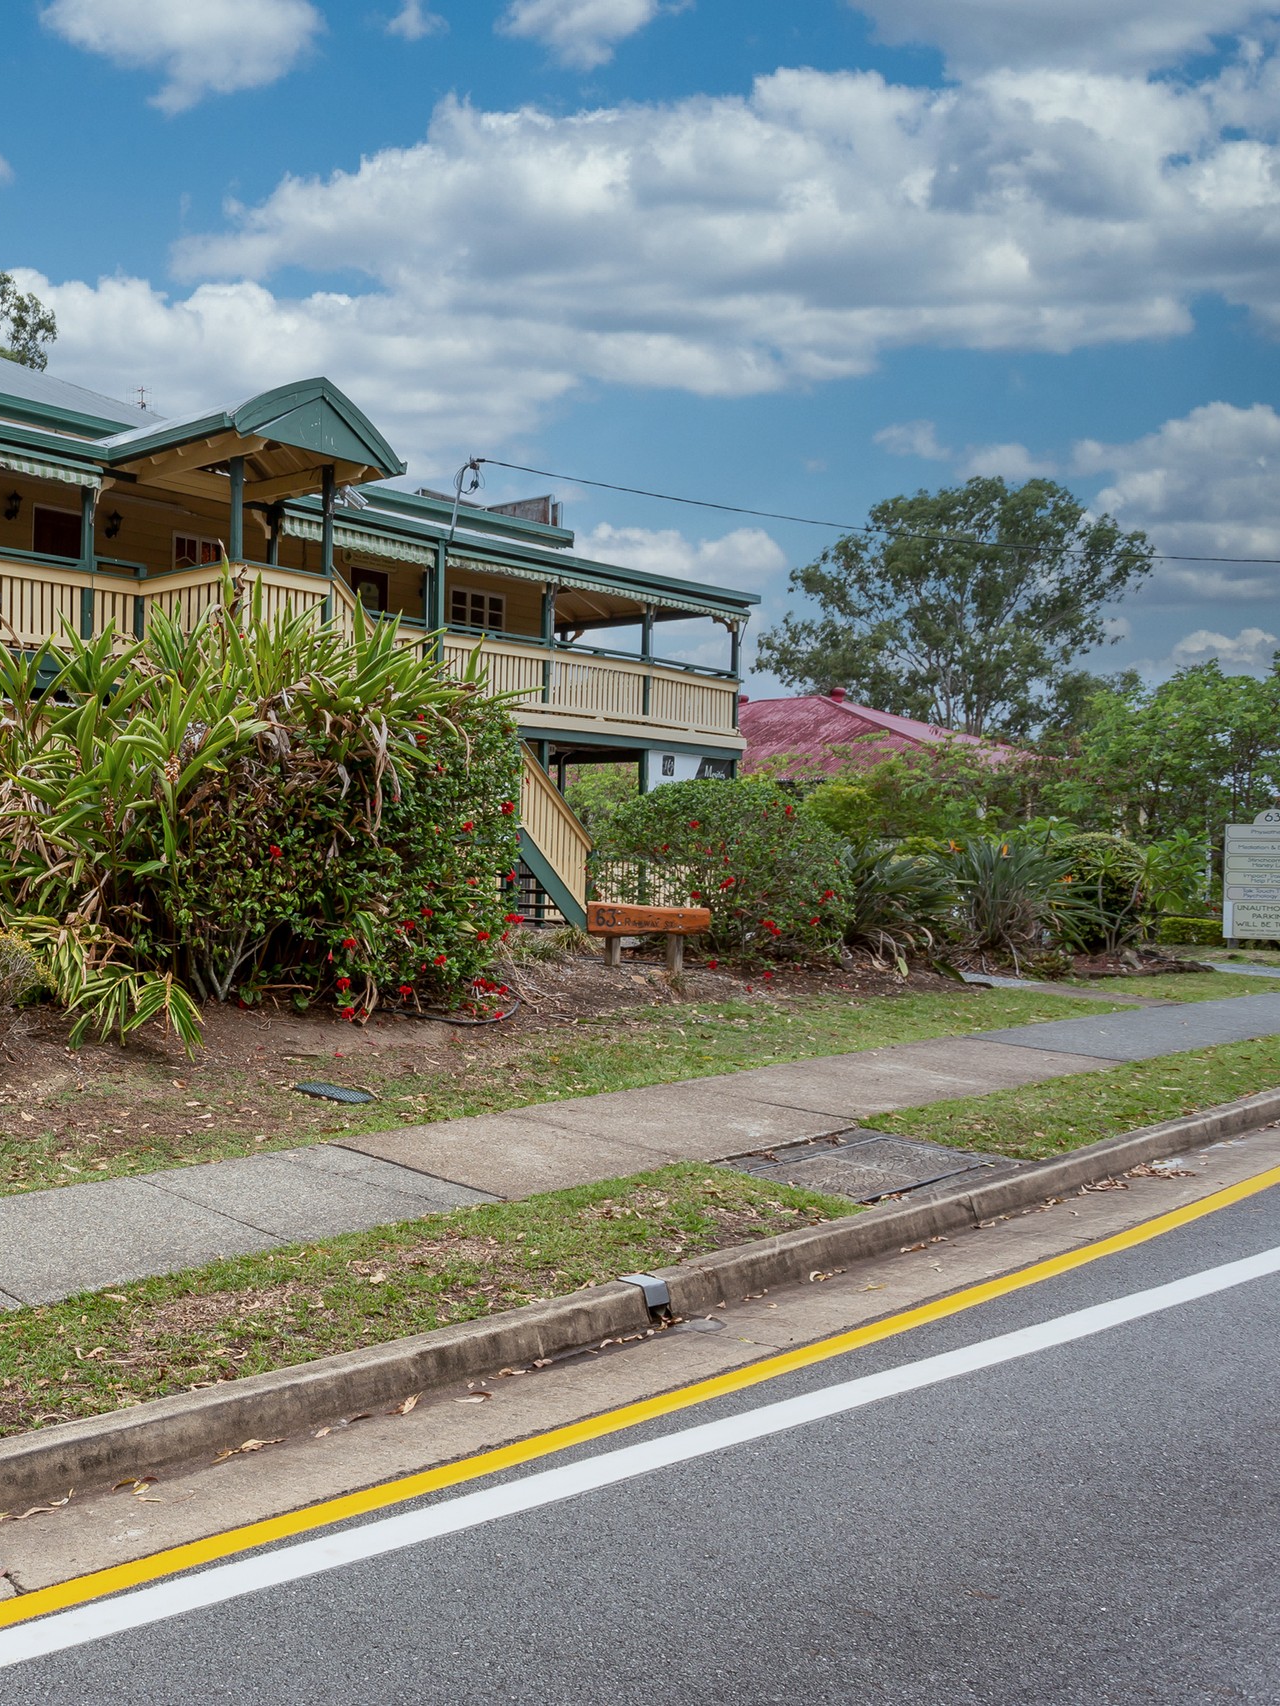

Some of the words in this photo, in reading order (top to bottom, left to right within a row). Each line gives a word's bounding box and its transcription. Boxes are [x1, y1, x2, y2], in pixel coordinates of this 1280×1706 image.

[1264, 812, 1280, 823] 63
[595, 908, 617, 928] 63
[1235, 920, 1258, 928] WILL
